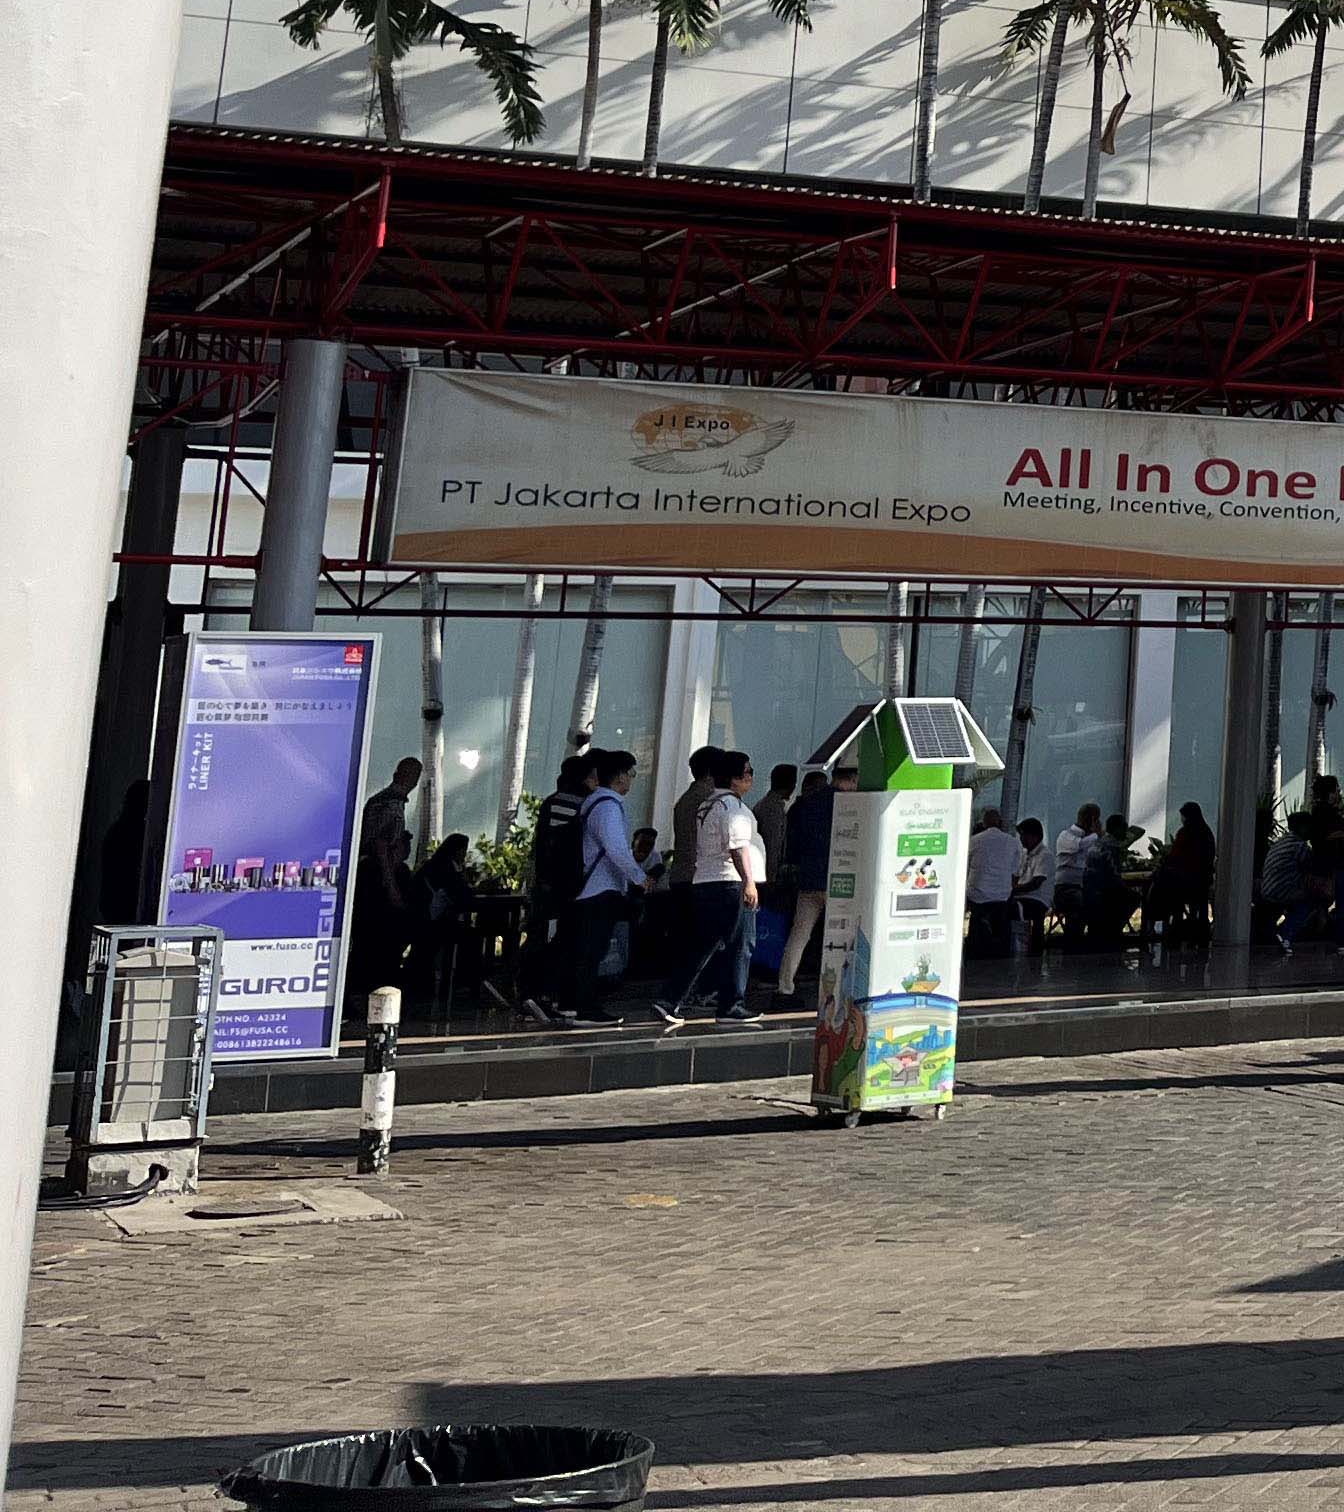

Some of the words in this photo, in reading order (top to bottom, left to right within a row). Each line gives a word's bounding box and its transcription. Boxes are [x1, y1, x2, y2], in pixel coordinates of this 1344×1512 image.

[1006, 447, 1090, 489] All
[1116, 453, 1171, 494] In
[1194, 457, 1317, 500] One
[441, 480, 483, 504] PT
[494, 481, 641, 510] Jakarta
[654, 487, 880, 520] International
[891, 498, 972, 525] Expo
[1003, 491, 1102, 514] Meeting,
[1109, 496, 1213, 519] Incentive,
[1219, 500, 1341, 523] Convention,
[203, 732, 213, 751] KIT
[198, 756, 211, 790] LINER
[250, 942, 313, 951] www.fusa.cc
[219, 976, 310, 996] GURO
